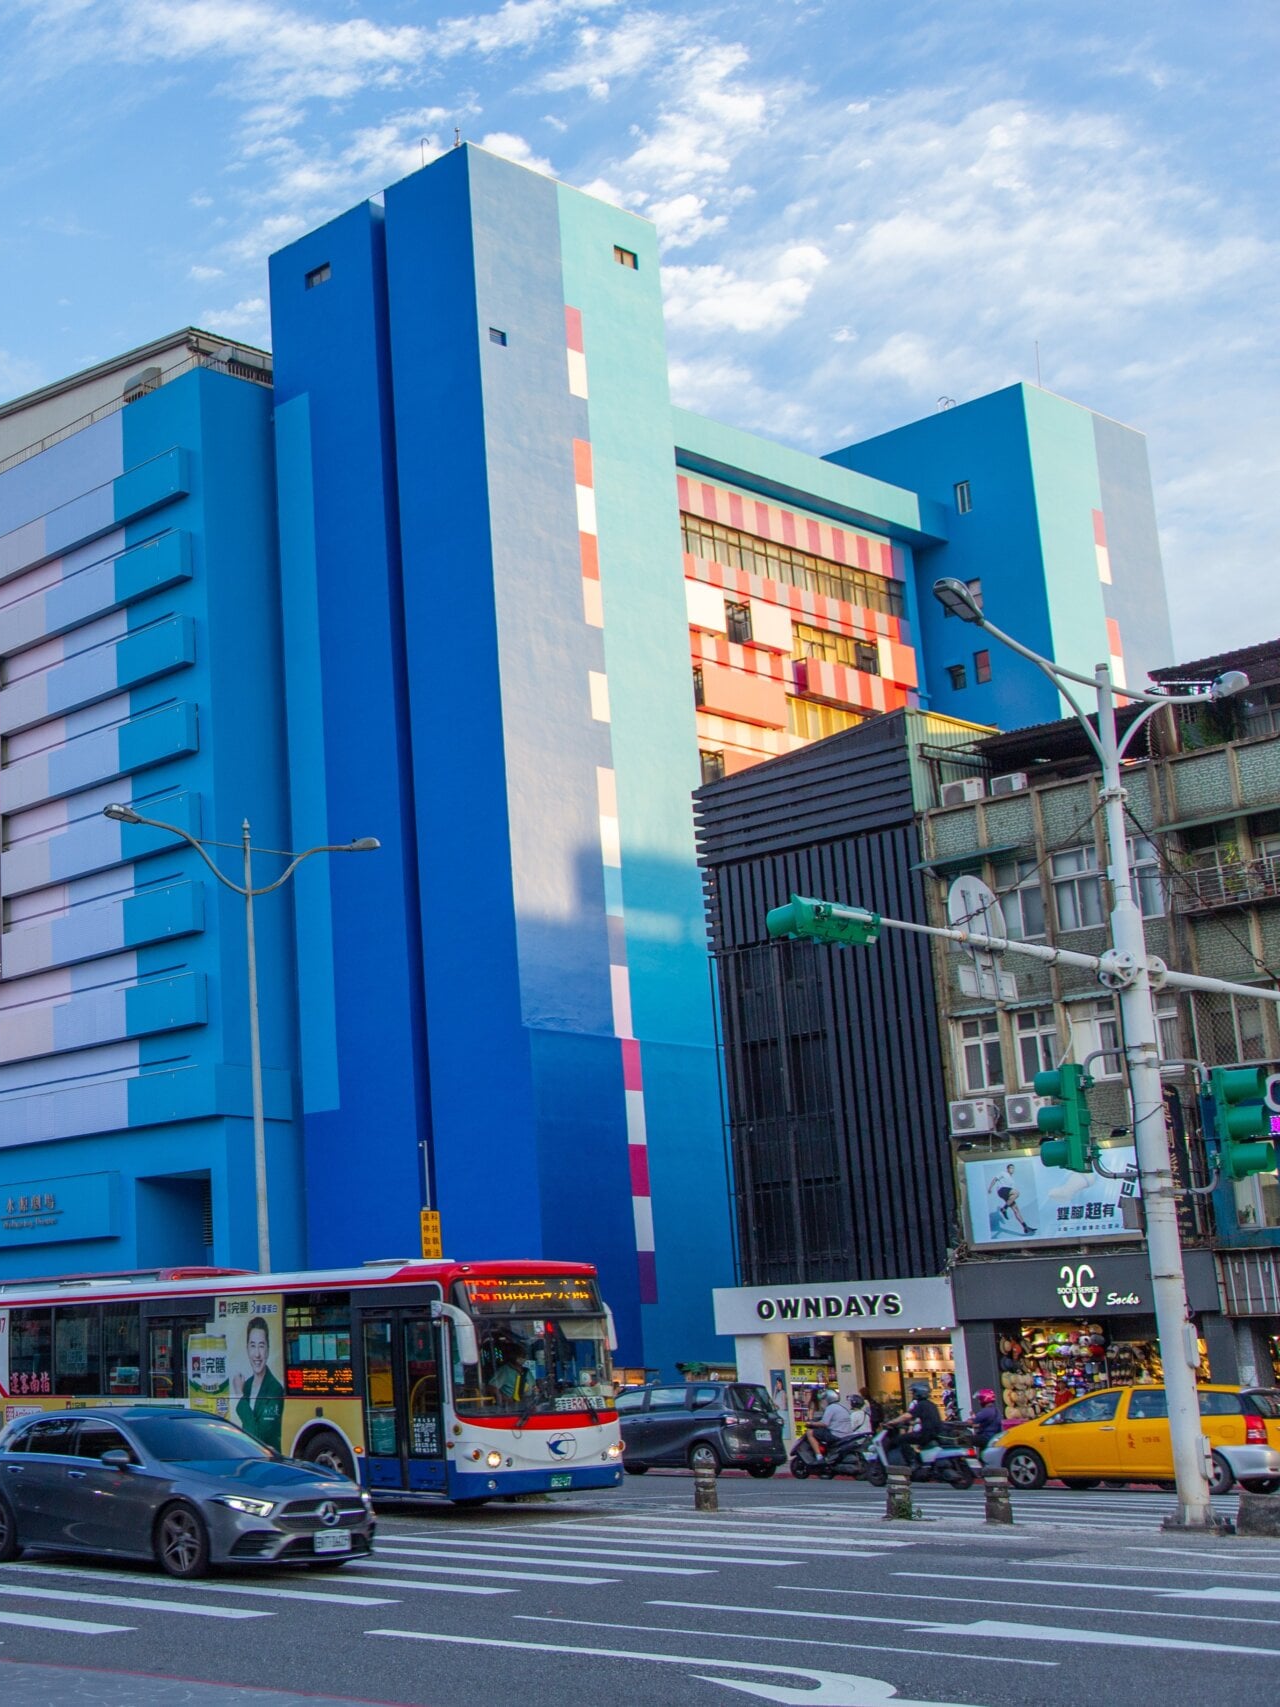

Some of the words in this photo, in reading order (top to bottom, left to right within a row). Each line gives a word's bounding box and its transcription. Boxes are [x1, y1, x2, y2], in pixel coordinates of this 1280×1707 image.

[1056, 1202, 1116, 1221] 雙腳超有
[756, 1292, 903, 1321] OWNDAYS
[1106, 1292, 1140, 1305] Socks
[206, 1356, 226, 1374] 完膳
